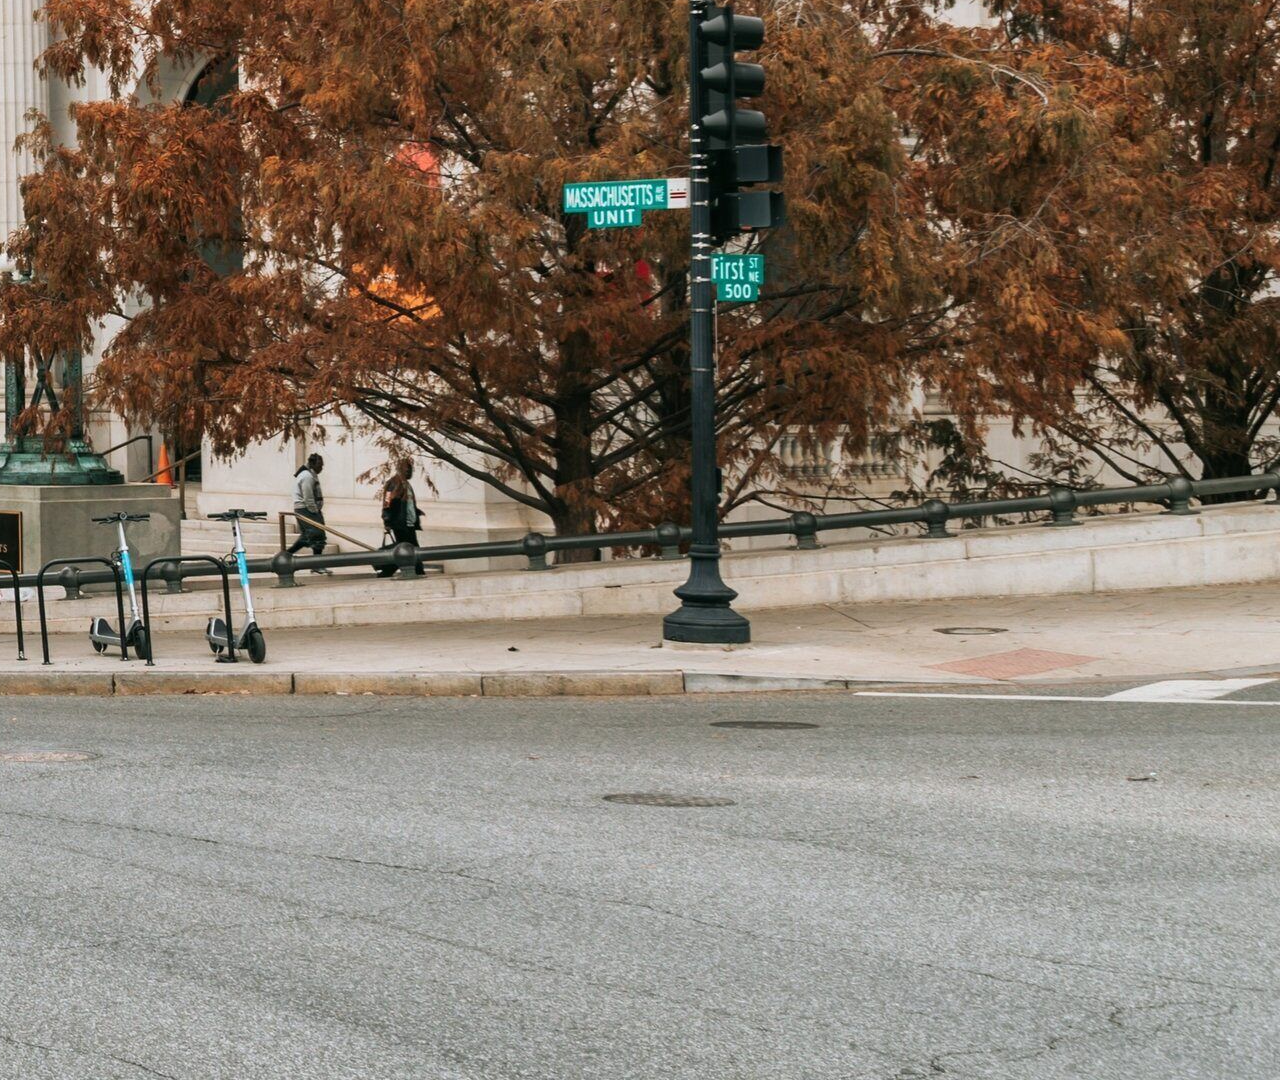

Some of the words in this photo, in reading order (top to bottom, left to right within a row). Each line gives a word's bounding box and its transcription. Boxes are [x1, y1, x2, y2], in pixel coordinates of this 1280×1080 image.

[566, 184, 654, 208] MASSACHUSETTS
[593, 209, 635, 225] UNIT
[712, 256, 744, 280] First
[749, 257, 759, 268] ST
[748, 271, 760, 282] NE
[725, 283, 752, 298] 500
